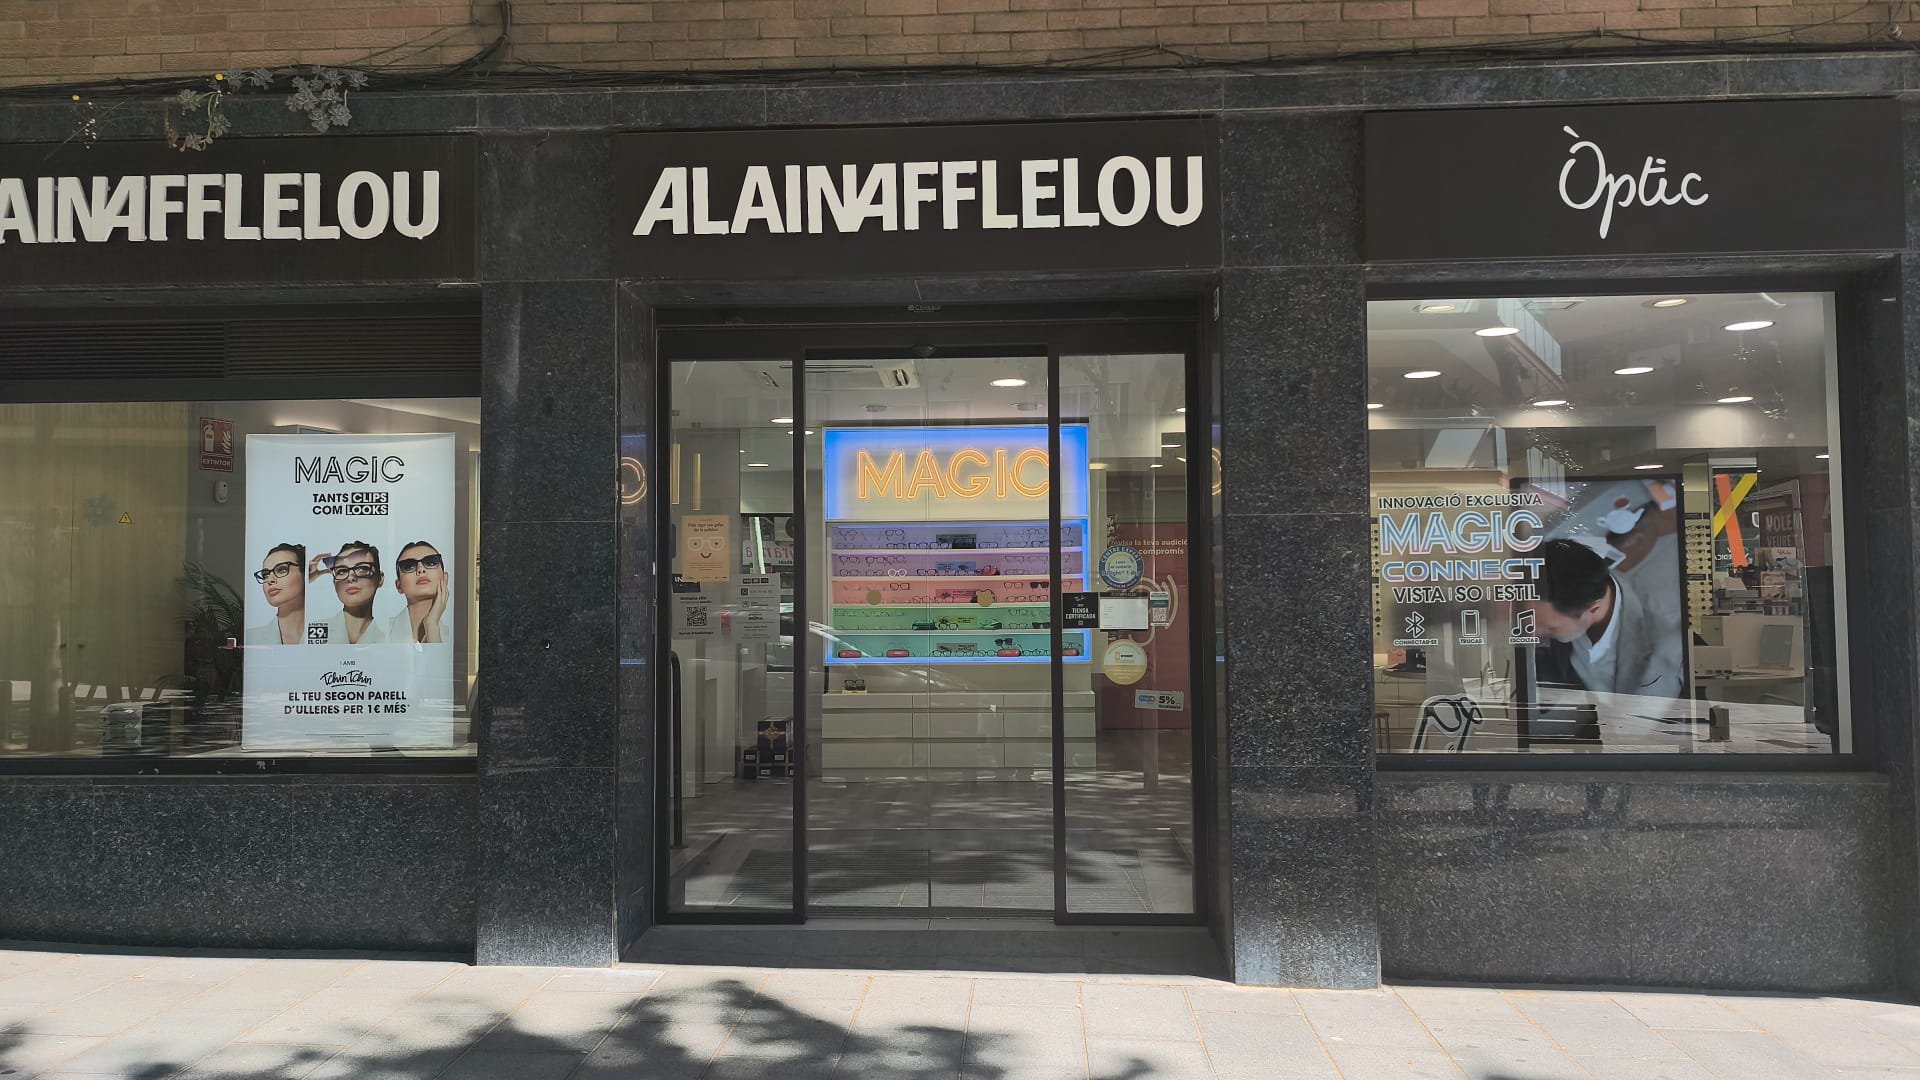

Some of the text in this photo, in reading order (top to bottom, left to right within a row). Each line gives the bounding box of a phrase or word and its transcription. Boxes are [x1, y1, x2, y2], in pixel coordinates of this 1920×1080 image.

[1559, 125, 1709, 239] Òptic
[295, 456, 405, 483] MAGIC
[857, 447, 1050, 499] MAGIC
[312, 492, 388, 503] TANTS CLIPS
[1378, 491, 1544, 510] INNOVACIÓ EXCLUSIVA
[312, 505, 388, 516] COM LOOKS
[1379, 509, 1544, 556] MAGIC
[1101, 547, 1121, 562] CENTRE
[1139, 547, 1184, 555] compromís
[1382, 558, 1546, 582] CONNECT
[1392, 584, 1540, 603] VISTA SO ESTIL
[320, 670, 372, 686] Tchin Tchin
[288, 691, 406, 701] EL TEU SEGON PARELL
[1158, 696, 1175, 705] 5%
[284, 705, 339, 715] D'ULLERES
[343, 705, 363, 714] PER
[368, 705, 380, 714] 1€
